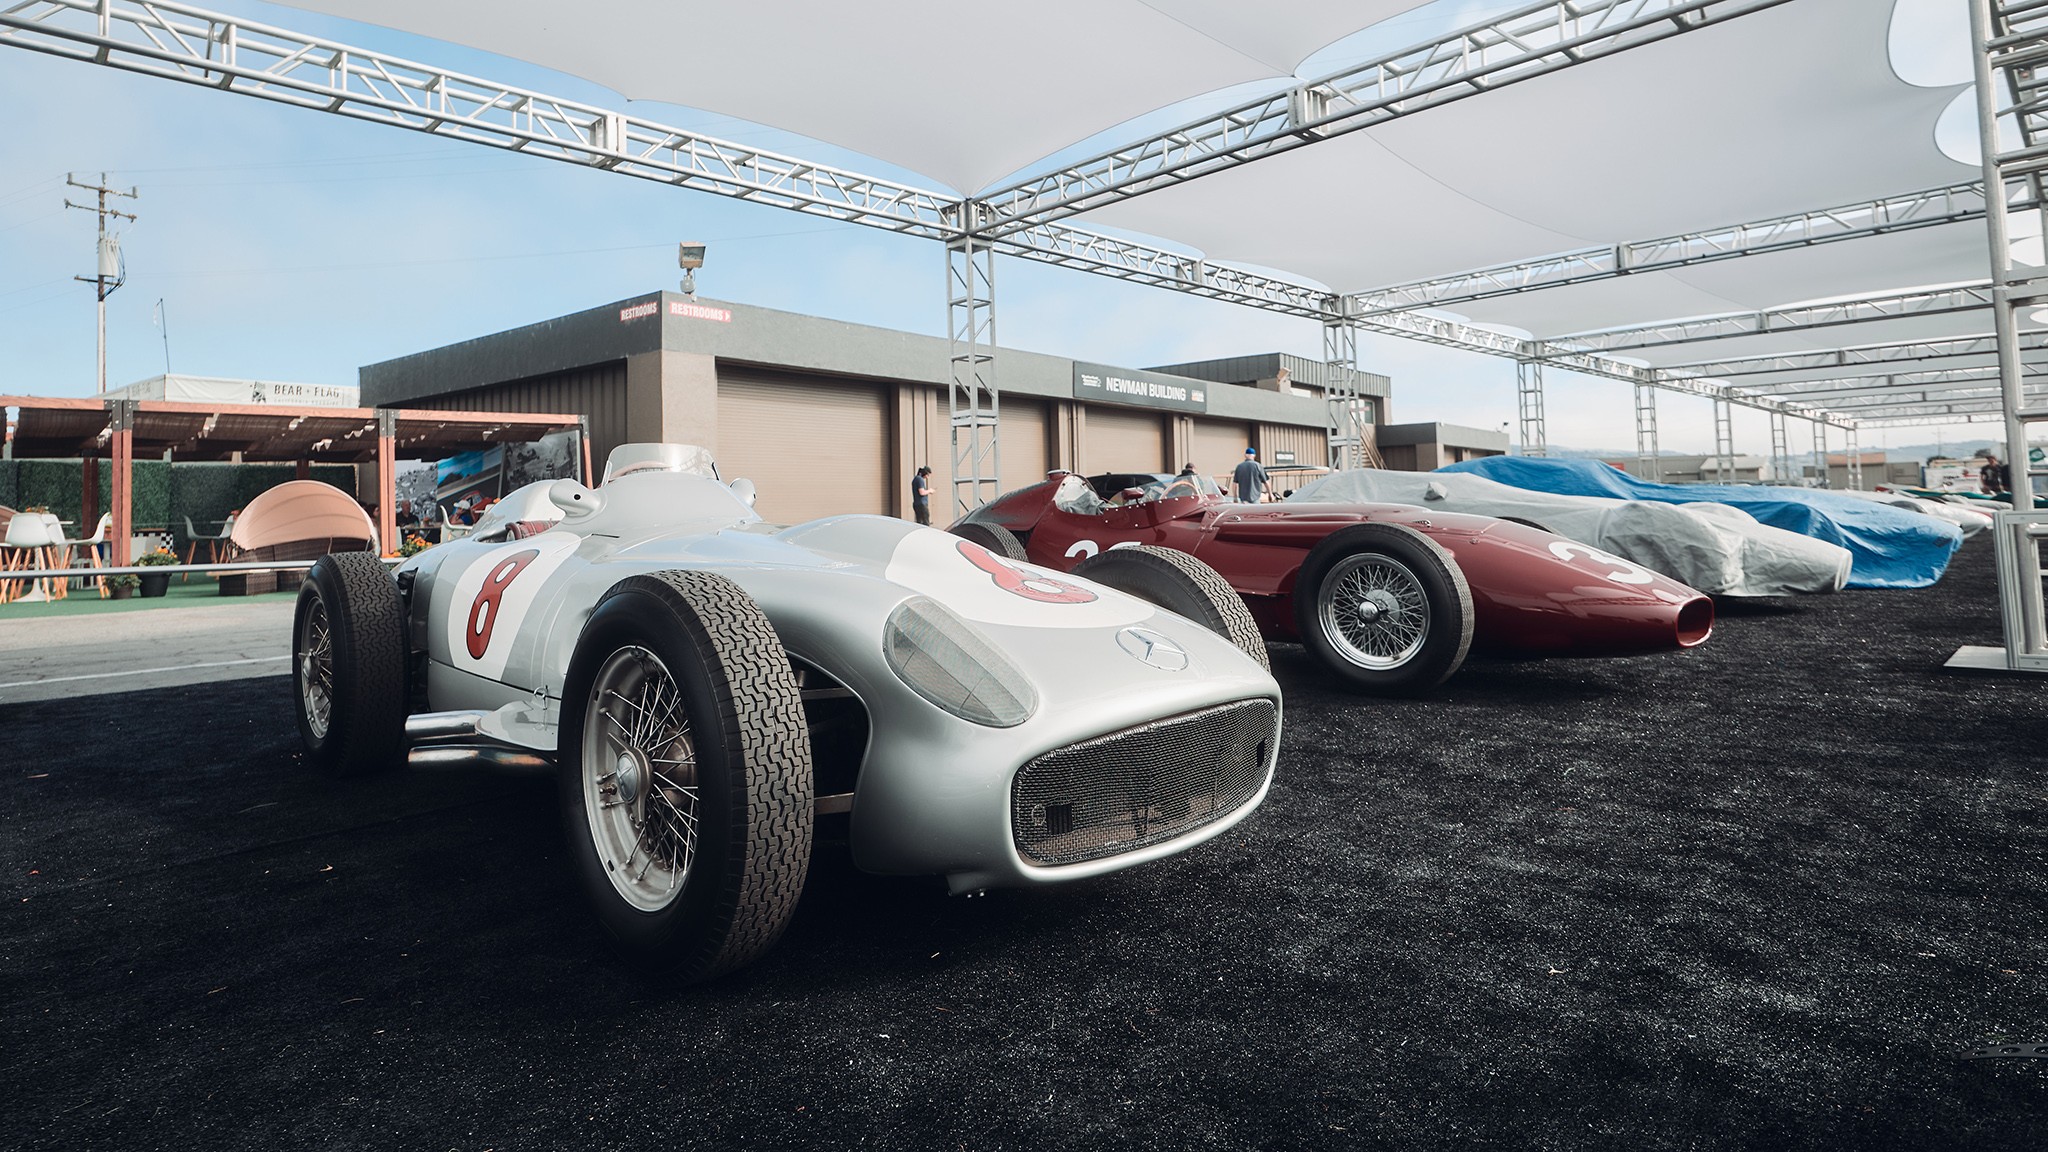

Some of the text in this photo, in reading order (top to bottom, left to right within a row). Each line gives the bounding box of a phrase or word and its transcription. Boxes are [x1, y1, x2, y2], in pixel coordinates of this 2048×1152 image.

[621, 303, 658, 320] RESTROOMS
[671, 303, 723, 320] RESTROOMS
[274, 384, 340, 398] BEAR FLAG
[1105, 377, 1148, 396] NEWMAN
[1149, 383, 1187, 401] BUILDING
[466, 548, 541, 660] 8
